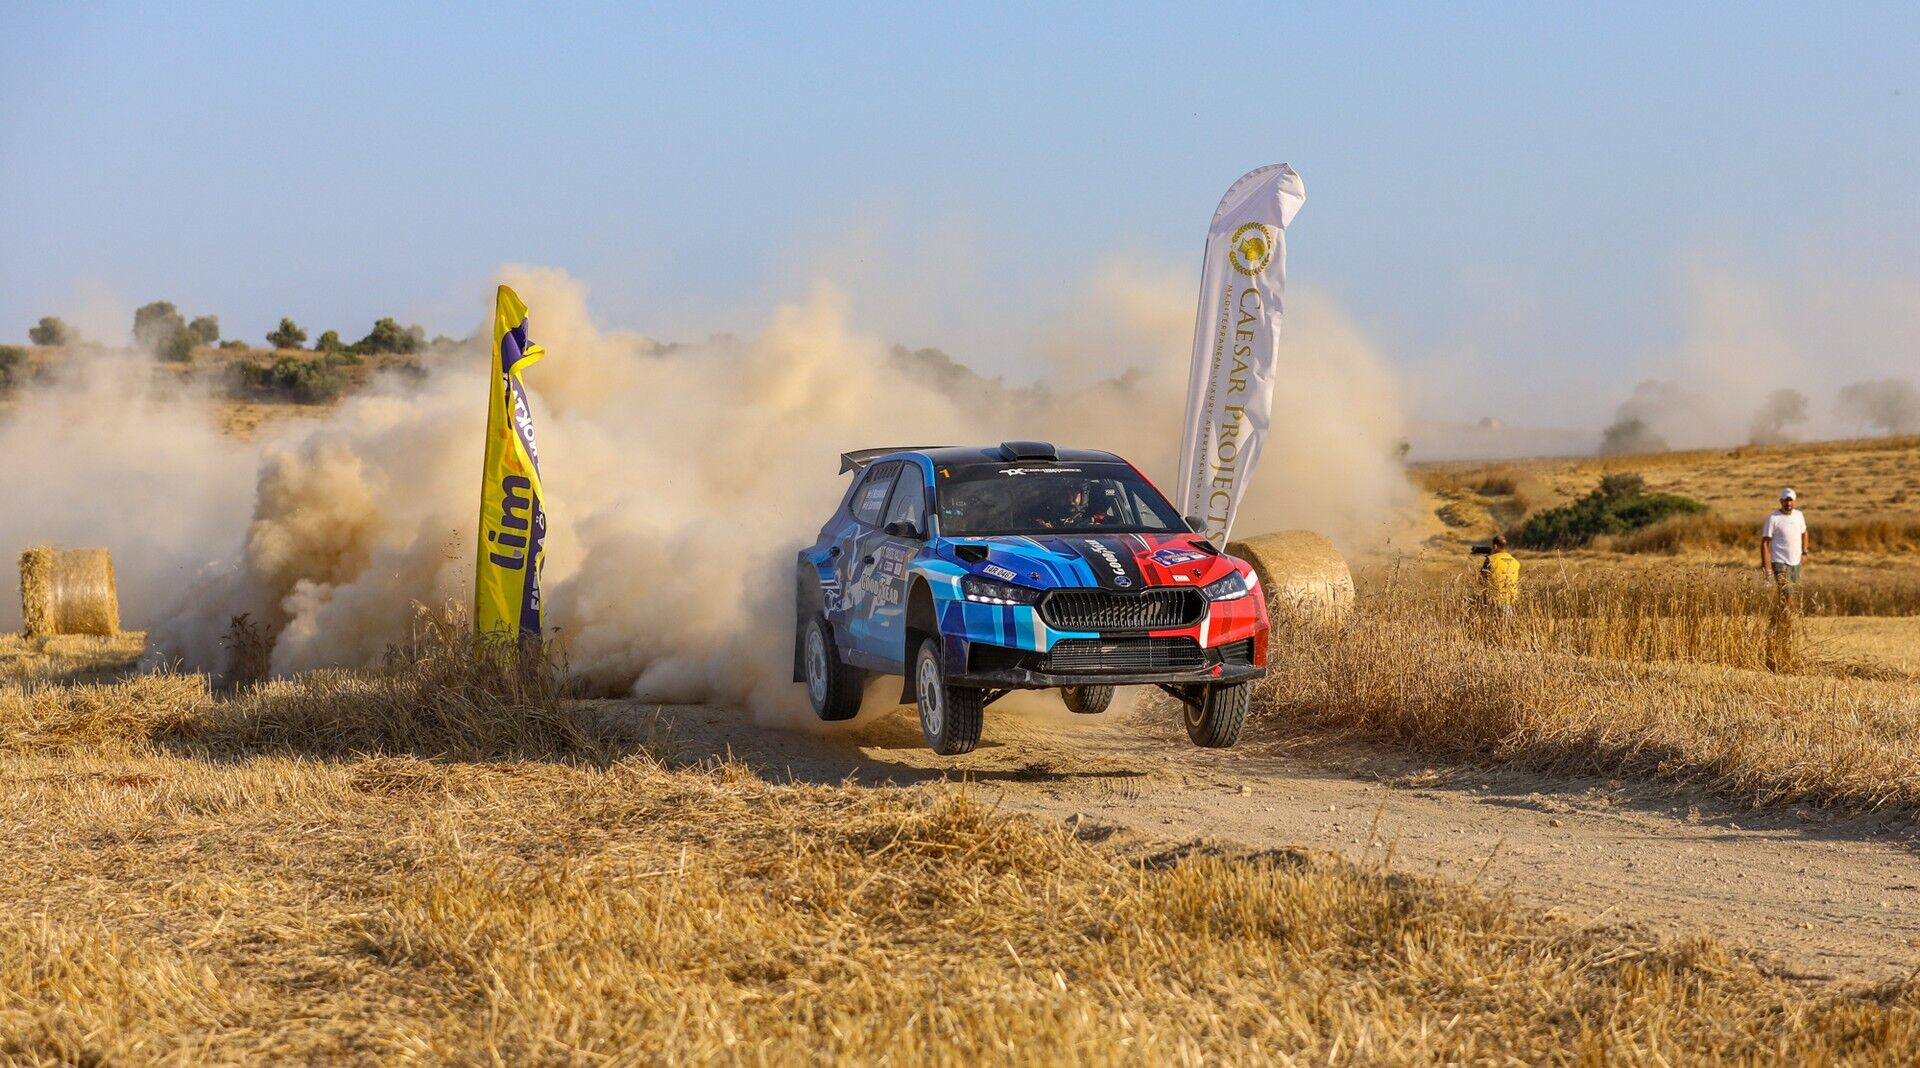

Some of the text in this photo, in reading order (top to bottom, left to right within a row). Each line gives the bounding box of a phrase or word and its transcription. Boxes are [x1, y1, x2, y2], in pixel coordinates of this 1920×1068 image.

[1214, 285, 1232, 369] MEDITERRANEAN
[1204, 287, 1261, 543] CAESAR PROJECTS
[1207, 375, 1218, 416] LUXURY
[1197, 420, 1211, 488] APARTMENTS
[488, 475, 531, 570] lim
